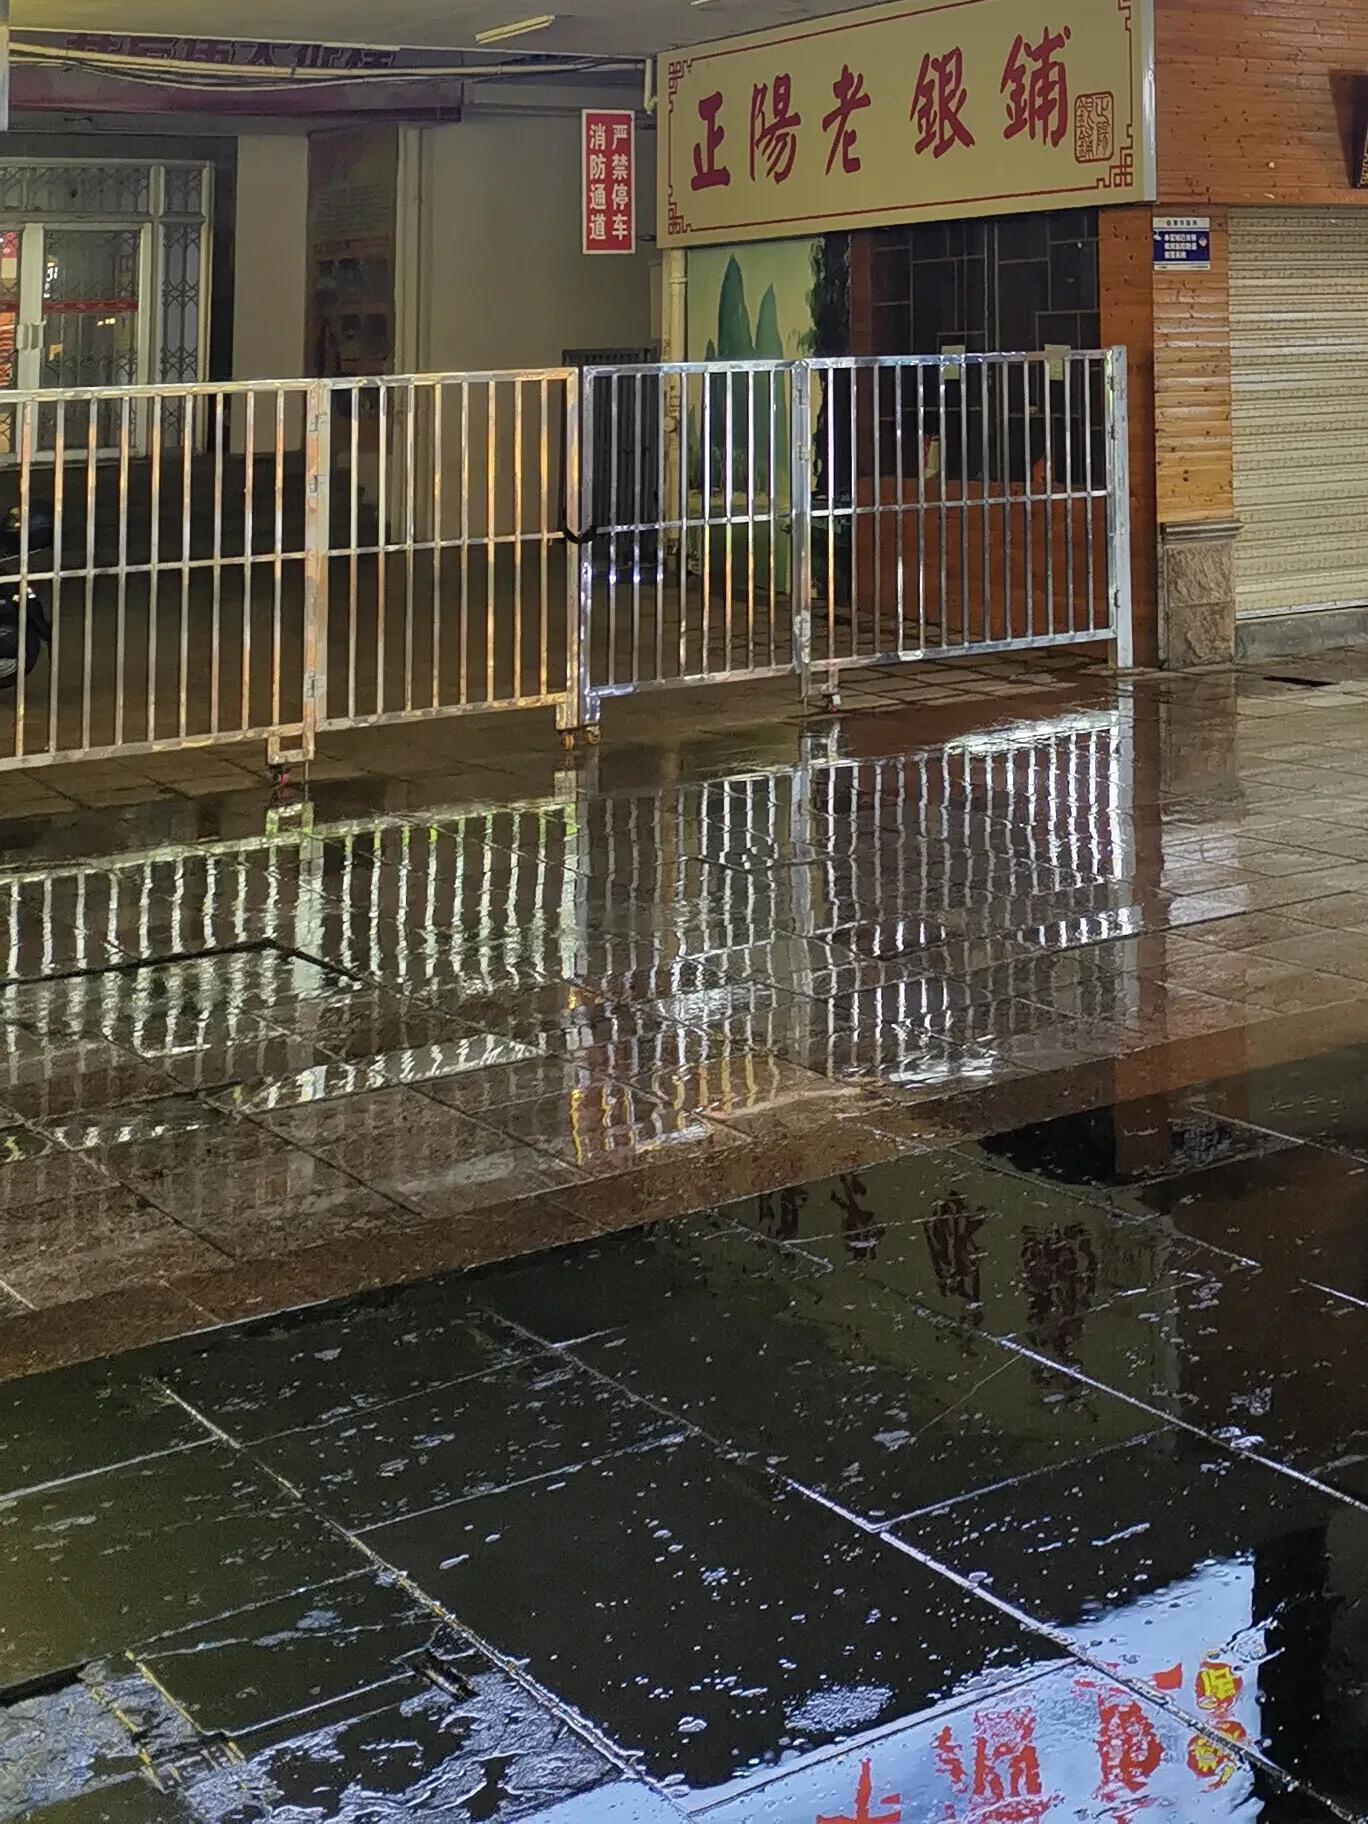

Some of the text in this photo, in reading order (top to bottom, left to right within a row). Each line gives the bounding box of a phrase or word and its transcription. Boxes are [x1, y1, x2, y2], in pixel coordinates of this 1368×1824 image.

[690, 25, 1072, 192] 正陽老銀鋪
[589, 123, 609, 241] 消防通道
[611, 123, 629, 241] 严禁停车
